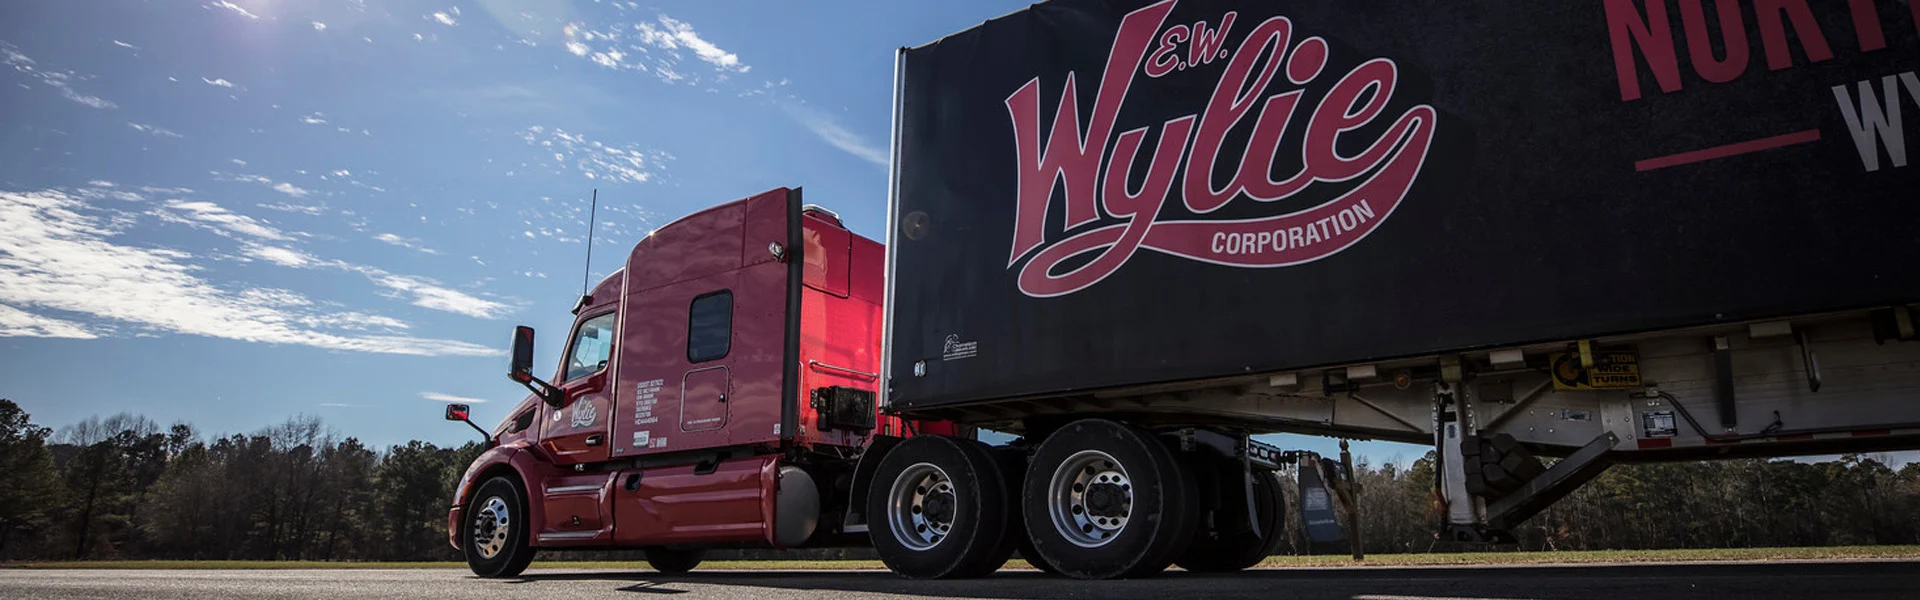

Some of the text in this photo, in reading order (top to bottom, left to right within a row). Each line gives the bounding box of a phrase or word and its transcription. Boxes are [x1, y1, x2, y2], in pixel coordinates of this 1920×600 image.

[1145, 11, 1238, 78] E.W.
[1004, 0, 1437, 298] Wylie
[1210, 199, 1376, 256] CORPORATION
[1593, 375, 1638, 384] TURNS
[1597, 364, 1631, 373] WIDE
